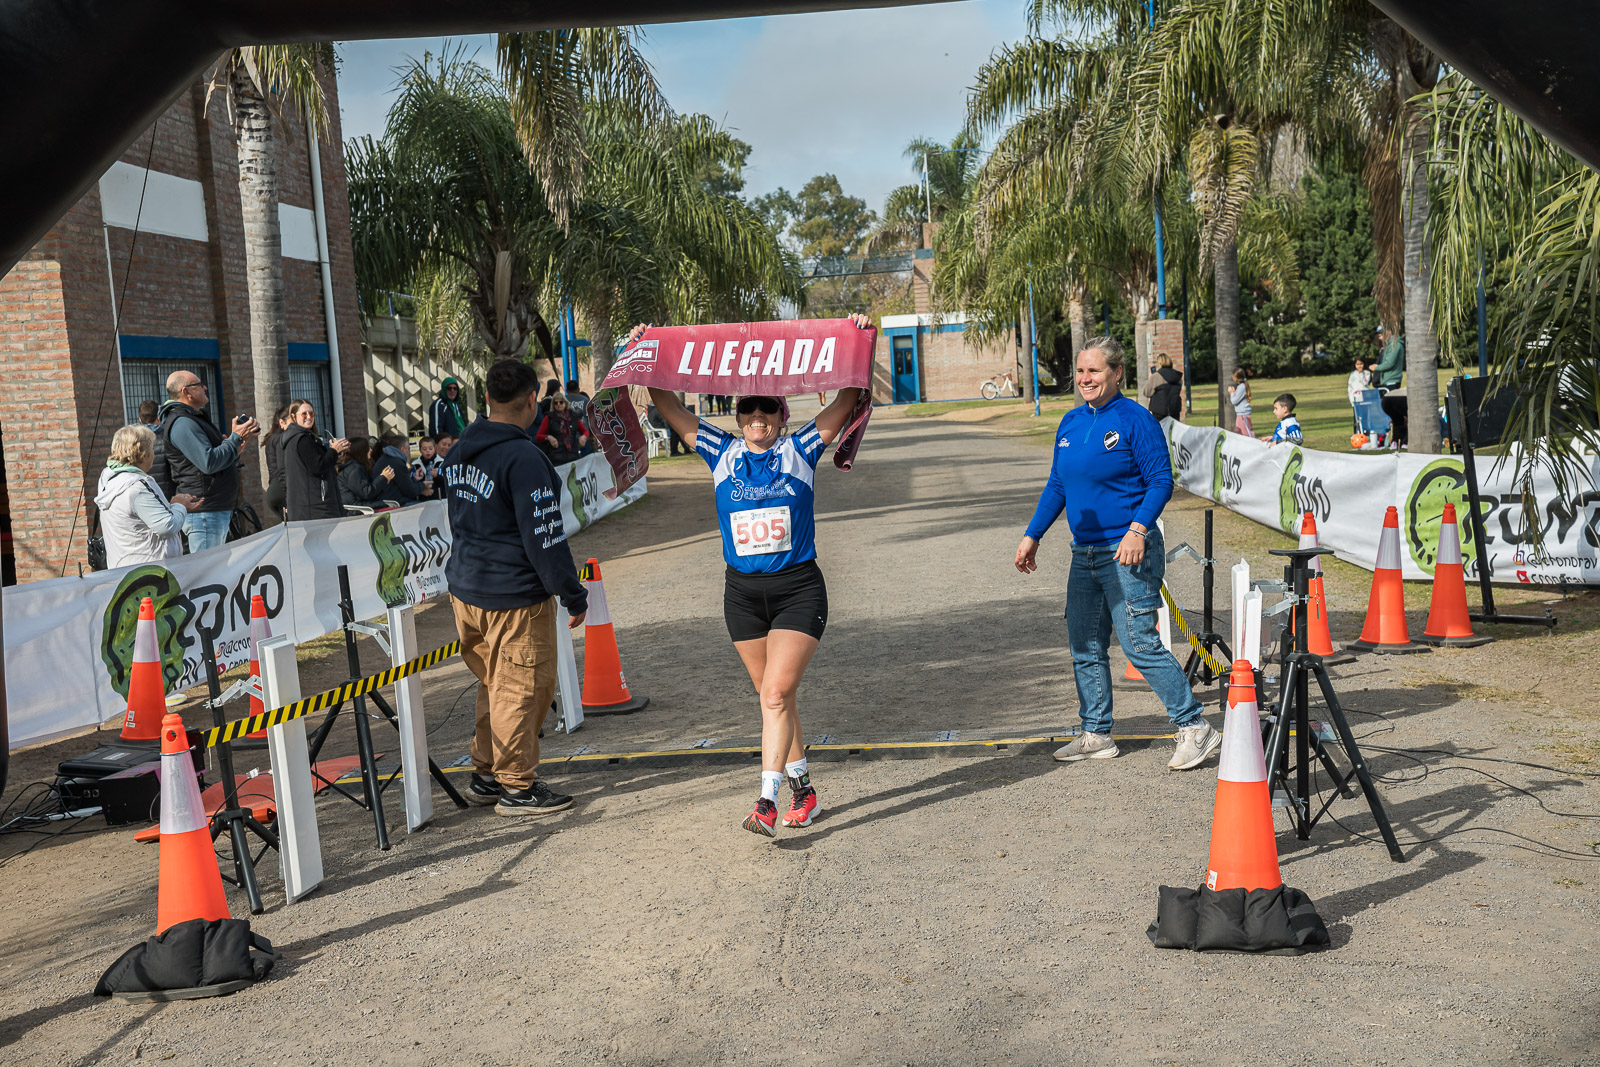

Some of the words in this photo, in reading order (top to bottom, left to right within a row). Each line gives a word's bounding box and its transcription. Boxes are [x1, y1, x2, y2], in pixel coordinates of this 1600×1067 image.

[677, 337, 837, 377] LLEGADA
[606, 367, 628, 379] SOS
[630, 364, 653, 373] VOS
[446, 463, 495, 500] BELGRANO
[530, 487, 542, 504] El
[736, 518, 787, 545] 505
